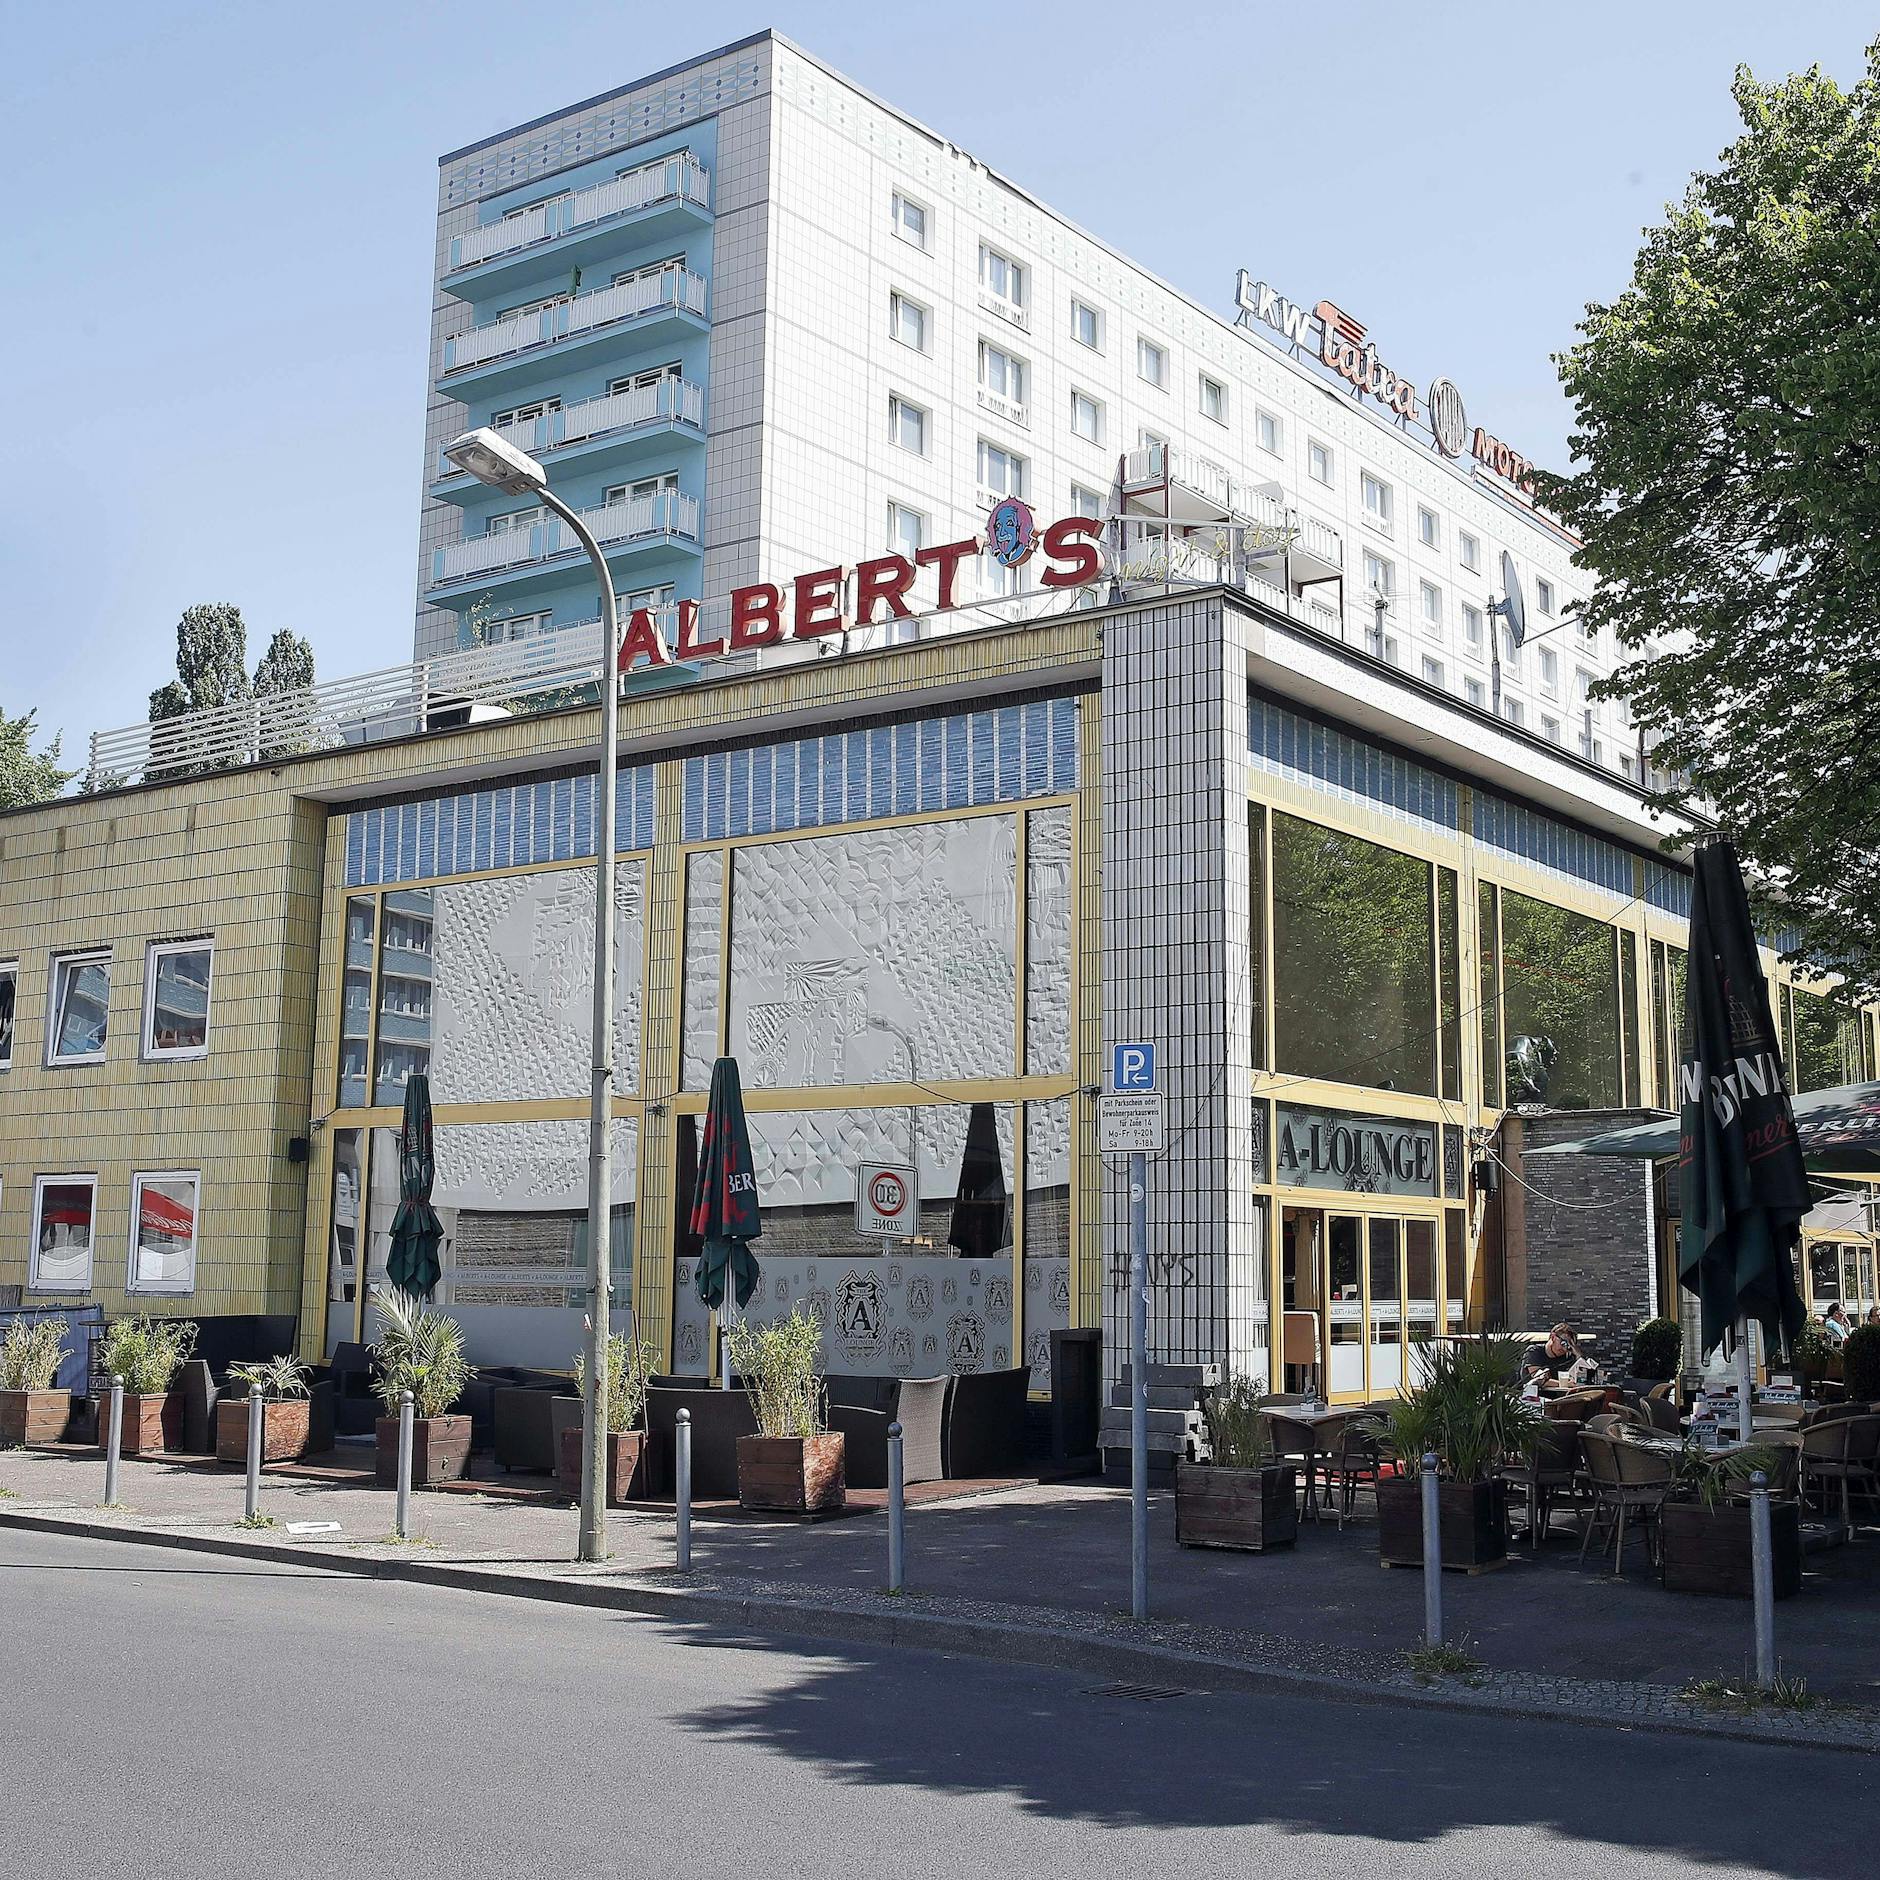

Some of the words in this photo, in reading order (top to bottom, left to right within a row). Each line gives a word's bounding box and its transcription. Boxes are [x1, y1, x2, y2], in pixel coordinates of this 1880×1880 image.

[1235, 269, 1312, 346] LKW
[1123, 1050, 1145, 1084] P
[1144, 1098, 1157, 1106] oder
[1119, 1118, 1127, 1127] für
[1129, 1118, 1141, 1127] Zone
[1108, 1129, 1130, 1138] Mo-Fr
[1133, 1128, 1153, 1137] 9-20h
[1134, 1139, 1154, 1147] 9-18h
[1277, 1119, 1434, 1184] A-LOUNGE
[848, 1300, 873, 1330] A
